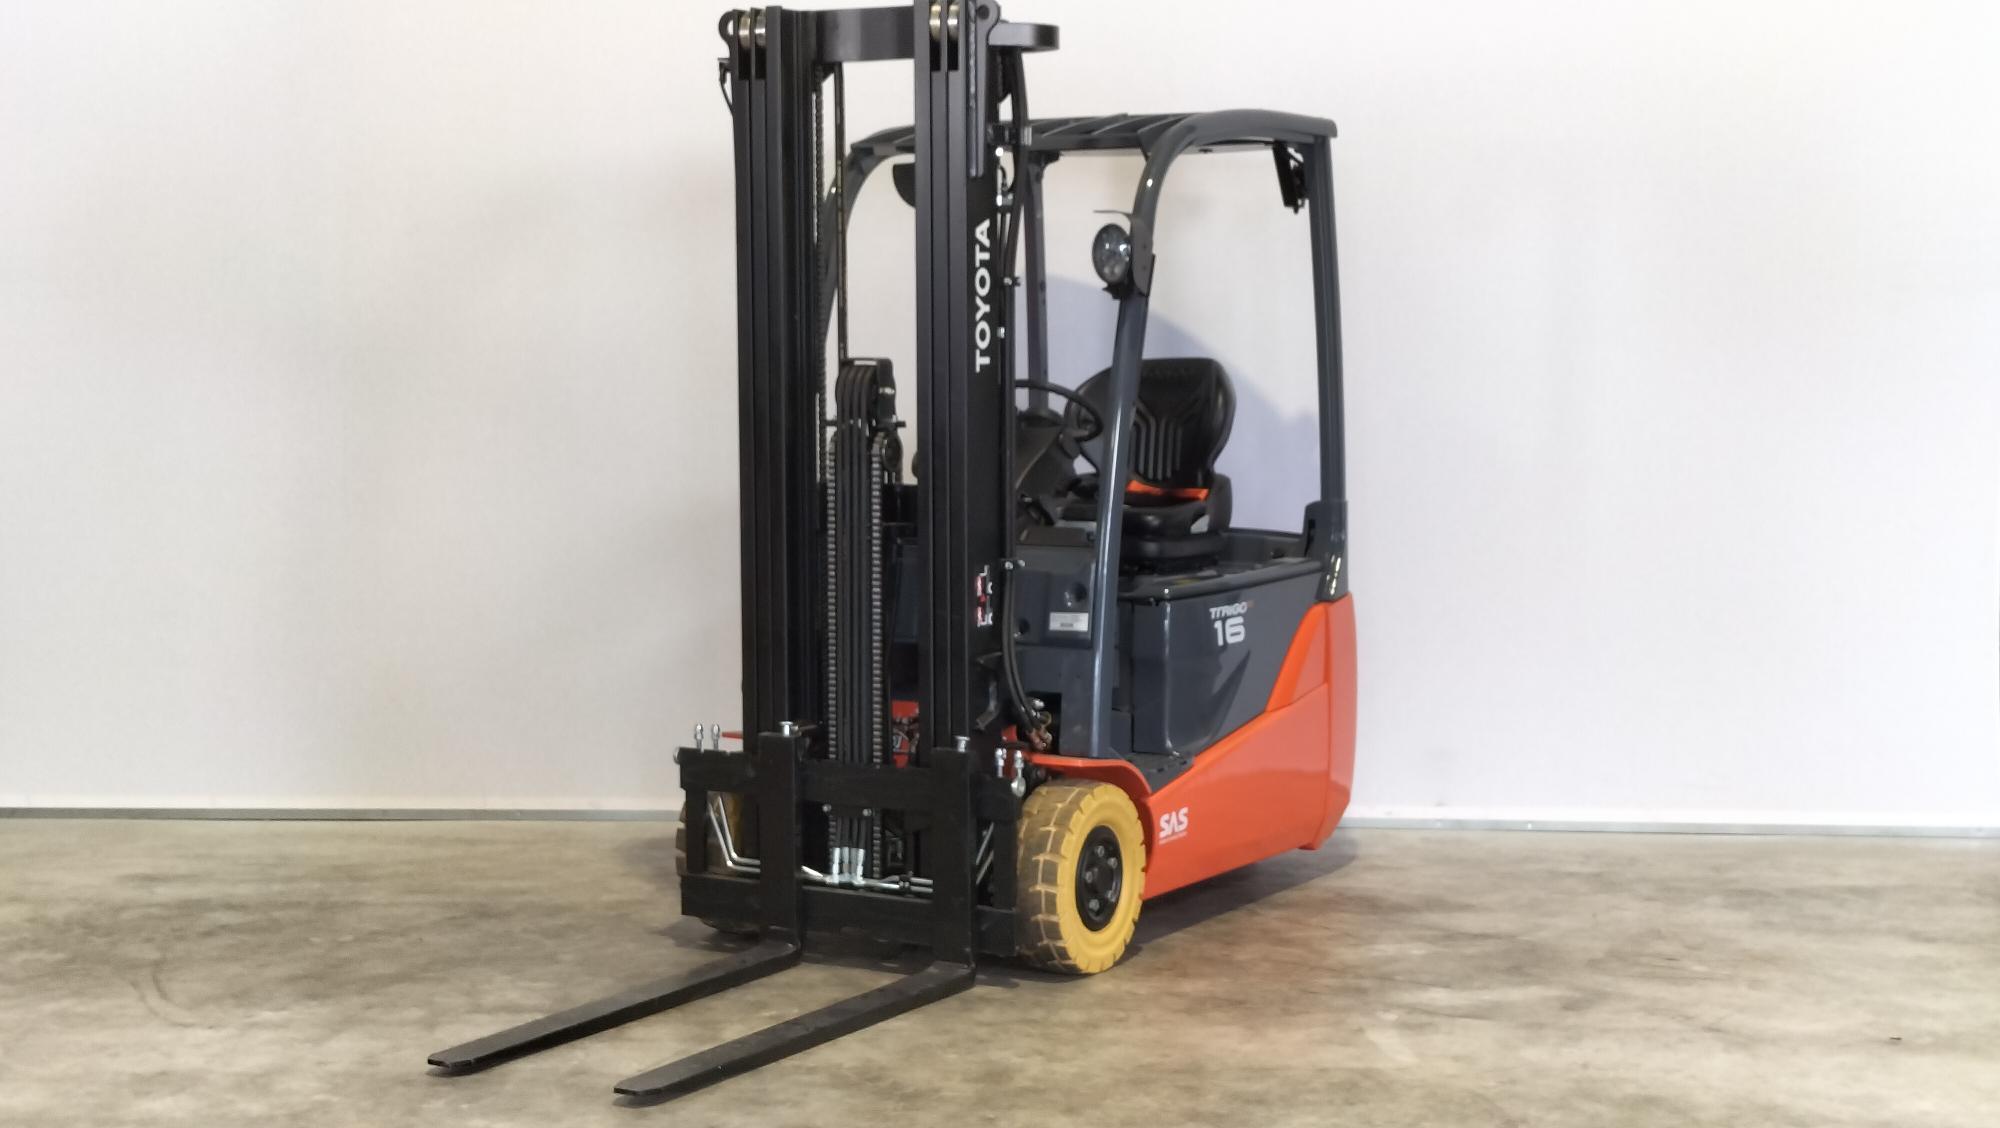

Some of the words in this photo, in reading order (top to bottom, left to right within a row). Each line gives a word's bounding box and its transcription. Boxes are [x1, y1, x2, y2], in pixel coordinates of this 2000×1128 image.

[975, 218, 991, 373] TOYOTA
[1214, 616, 1246, 646] 16
[1159, 806, 1189, 839] SAS
